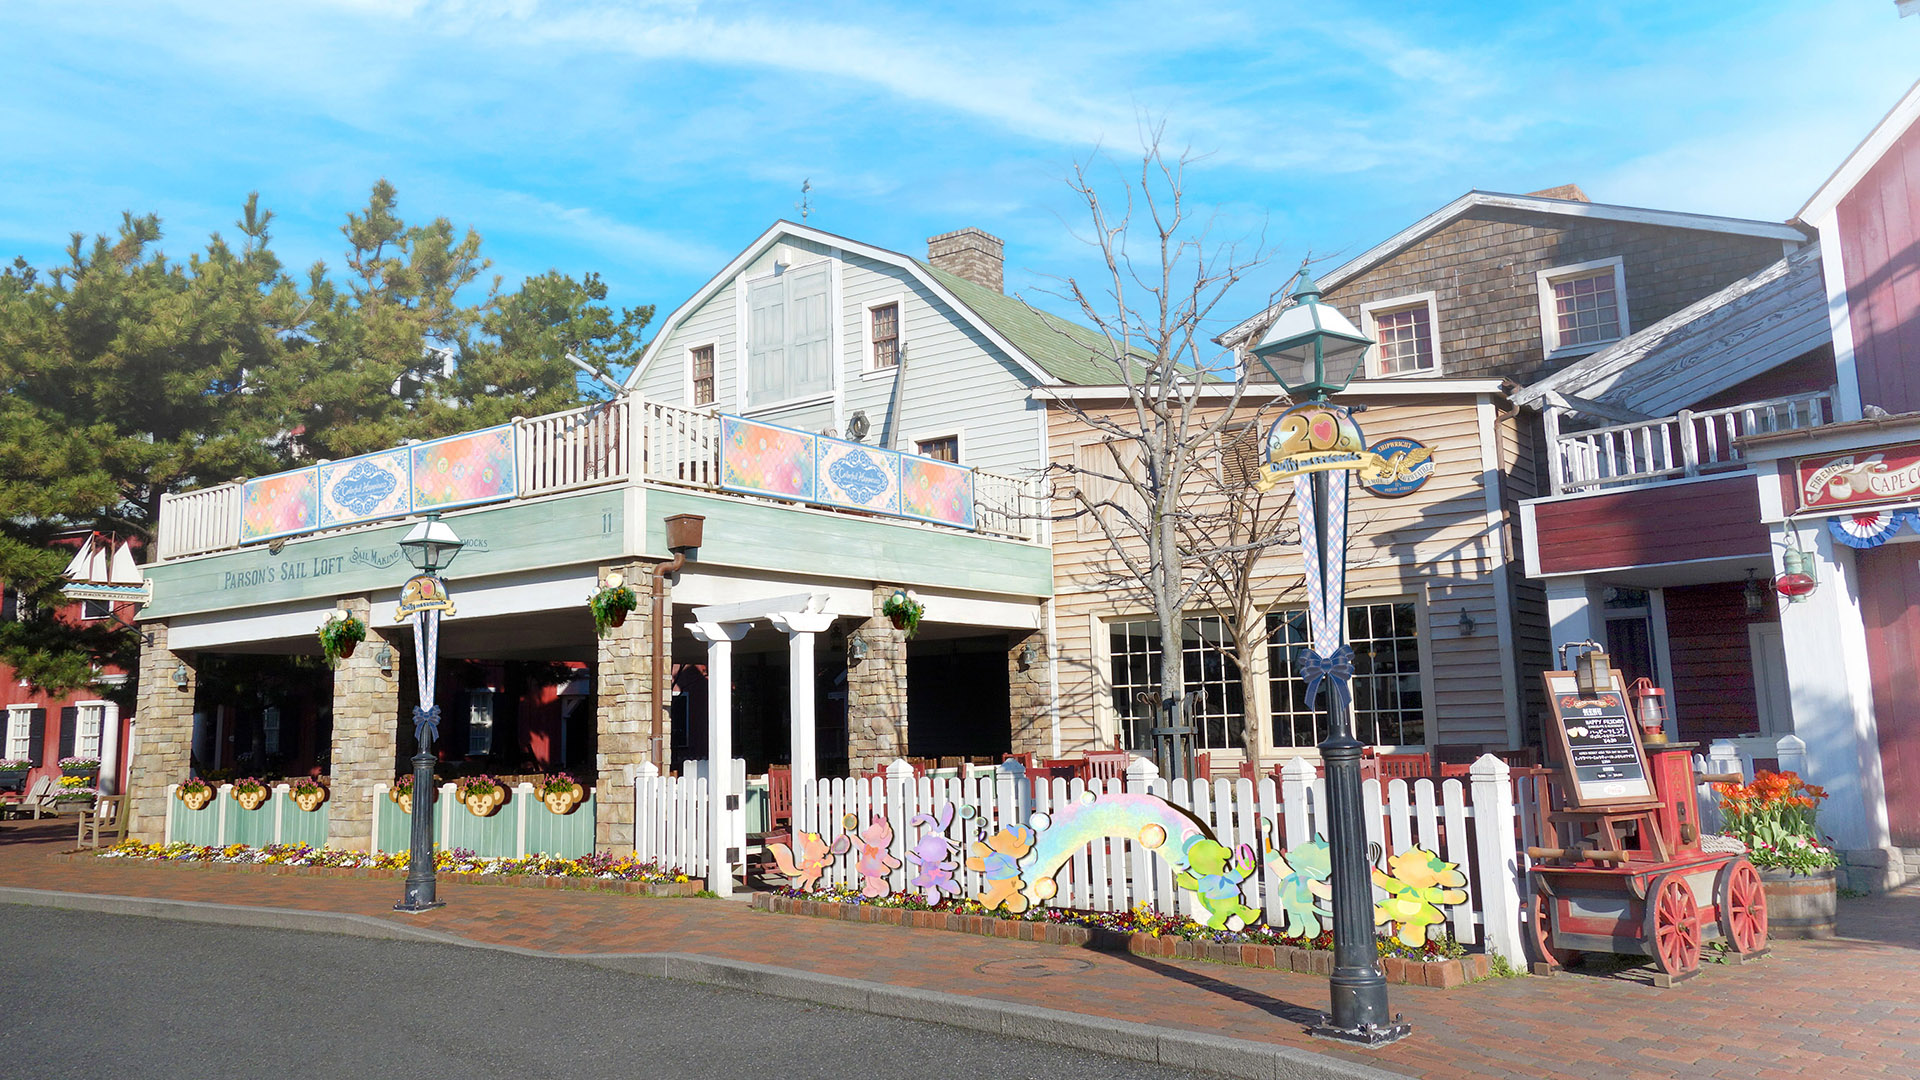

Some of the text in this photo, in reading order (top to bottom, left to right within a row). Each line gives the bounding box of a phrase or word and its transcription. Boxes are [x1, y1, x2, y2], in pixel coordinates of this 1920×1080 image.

[1280, 412, 1339, 451] 20
[1377, 441, 1412, 452] SHIPWRIGHT
[1270, 457, 1299, 472] Duffy
[1809, 458, 1851, 490] FIREMEN'S
[1870, 464, 1920, 492] CAPE C
[602, 512, 612, 533] 11
[351, 546, 370, 562] SAIL
[370, 549, 399, 566] MAKING
[223, 556, 344, 590] PARSON'S SAIL LOFT
[406, 579, 435, 601] 20
